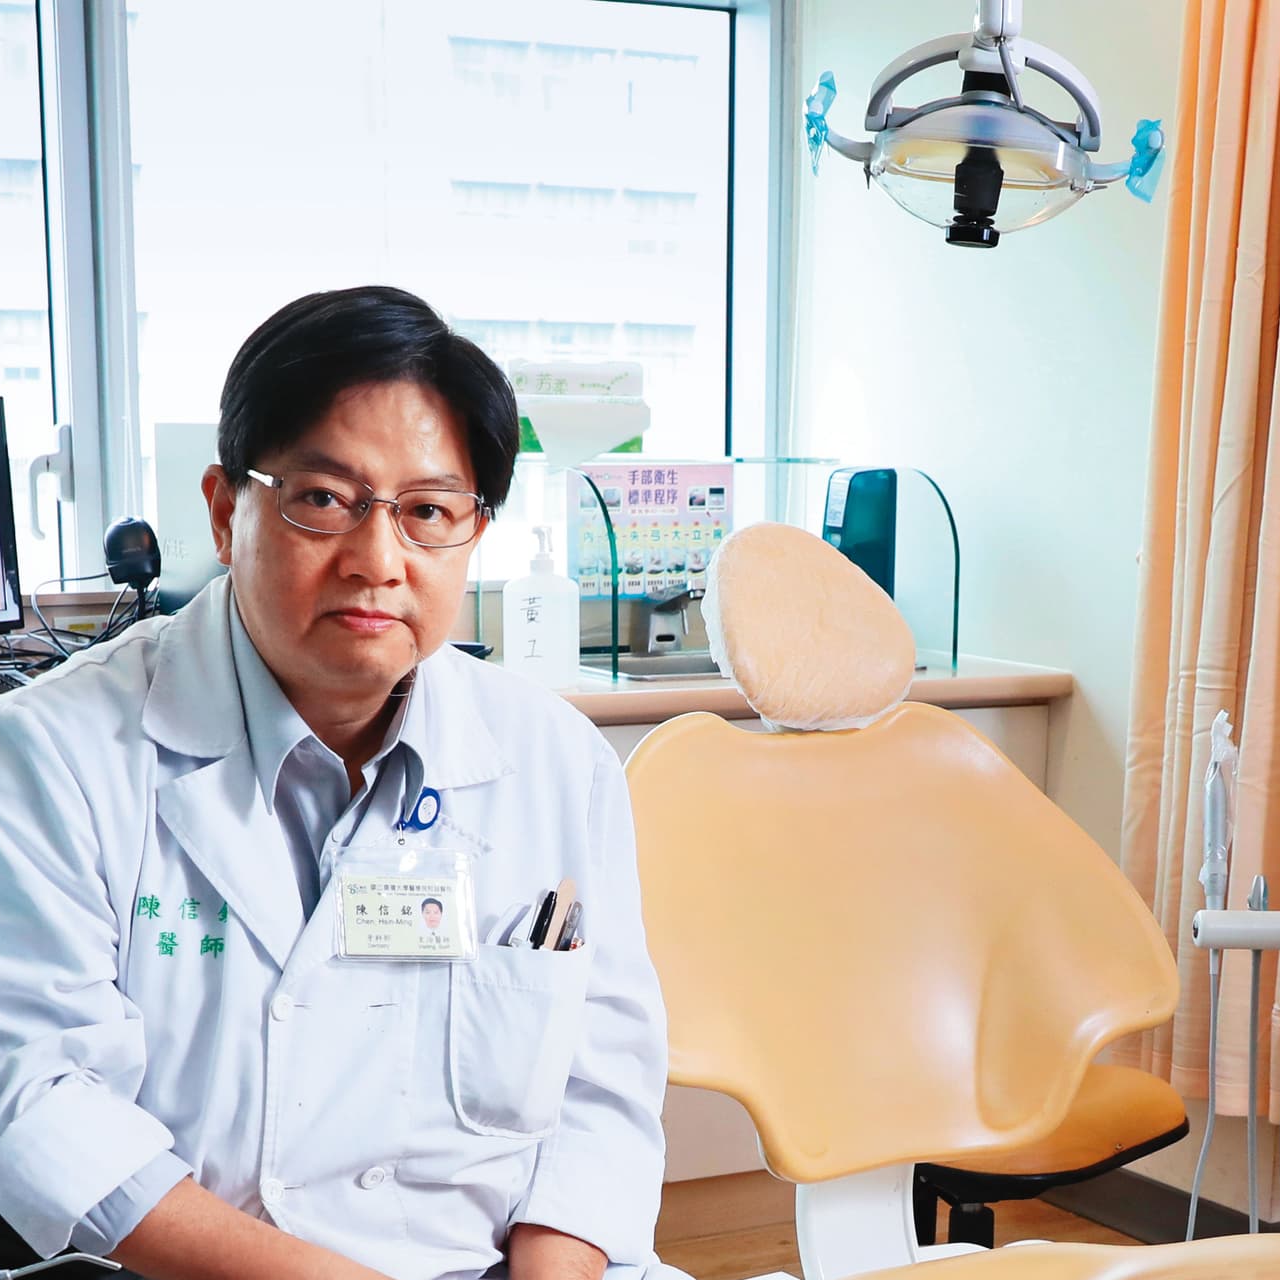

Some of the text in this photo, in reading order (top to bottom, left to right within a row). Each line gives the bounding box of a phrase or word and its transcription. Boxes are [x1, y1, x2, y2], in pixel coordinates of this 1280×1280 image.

[628, 470, 678, 485] 手部衛生
[628, 489, 678, 505] 標準程序
[156, 931, 225, 959] 醫師
